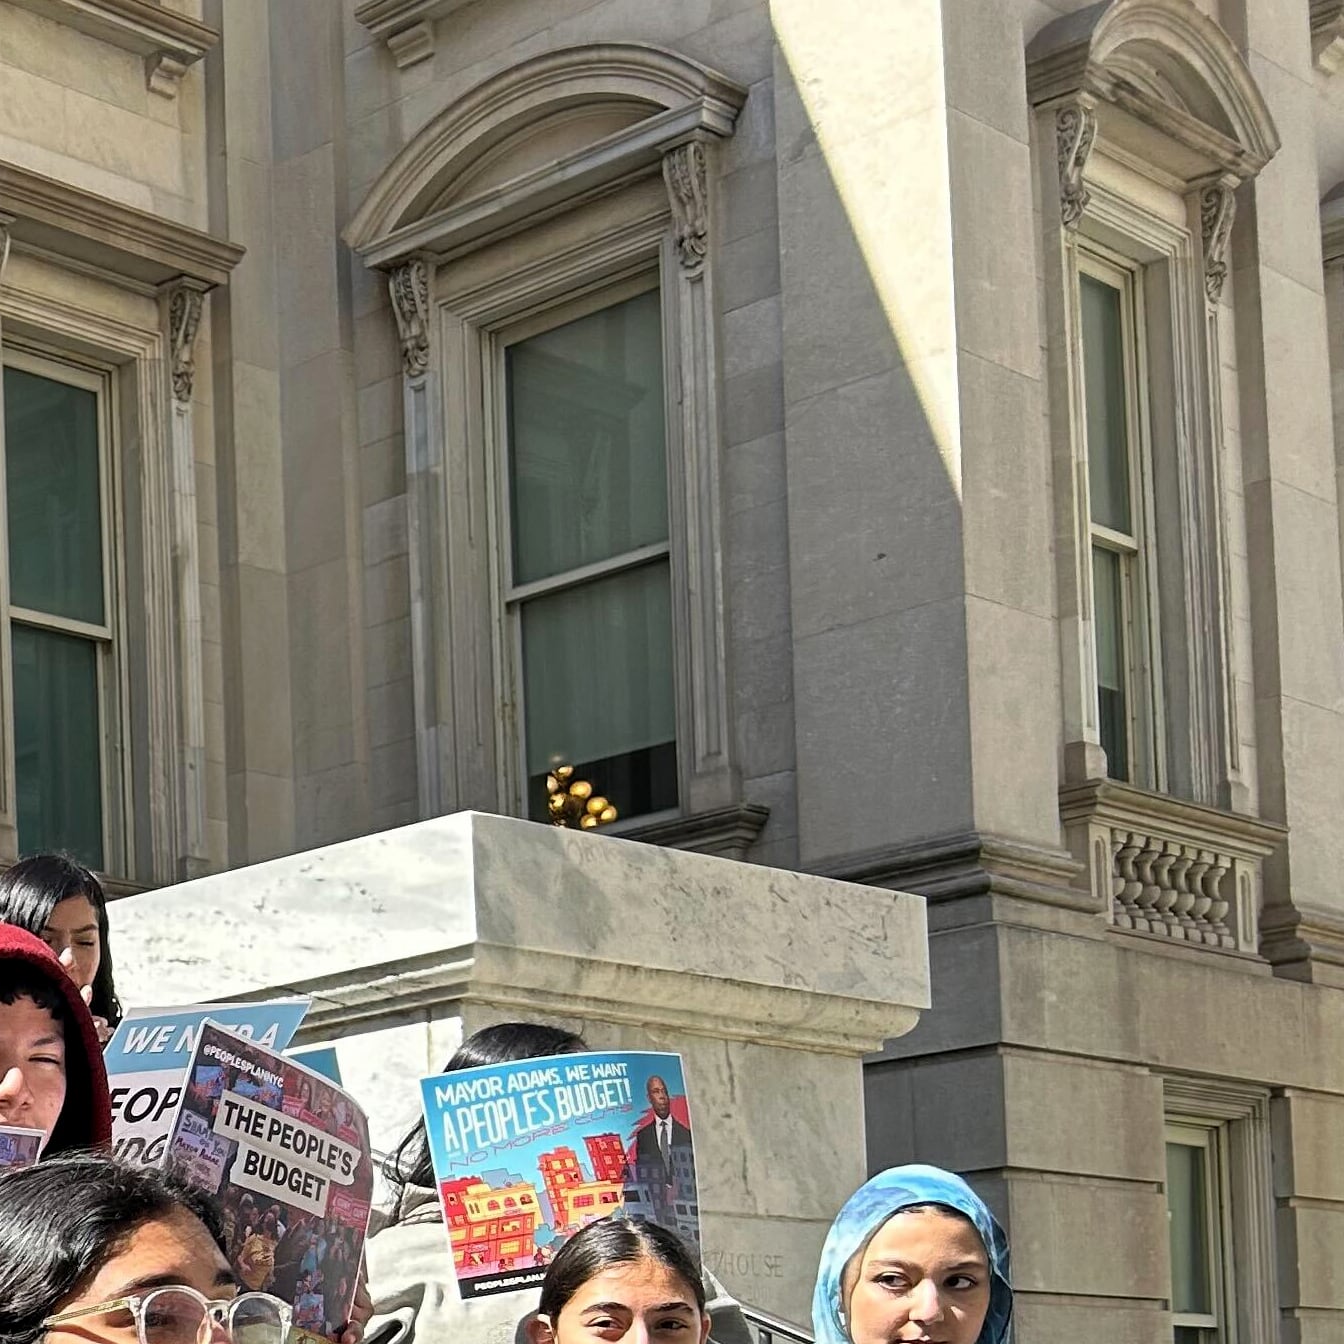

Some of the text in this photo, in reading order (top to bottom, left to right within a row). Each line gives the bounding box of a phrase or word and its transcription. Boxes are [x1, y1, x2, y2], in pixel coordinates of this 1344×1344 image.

[122, 1024, 177, 1055] WE
[202, 1042, 284, 1089] @PEOPLESPLANNYC
[434, 1075, 508, 1109] MAYOR
[564, 1063, 591, 1082] WE
[590, 1062, 628, 1078] WANT
[223, 1099, 267, 1139] THE
[267, 1115, 354, 1177] PEOPLE'S
[442, 1077, 633, 1155] A PEOPLE'S BUDGET!
[243, 1149, 326, 1202] BUDGET
[449, 1149, 489, 1171] NO
